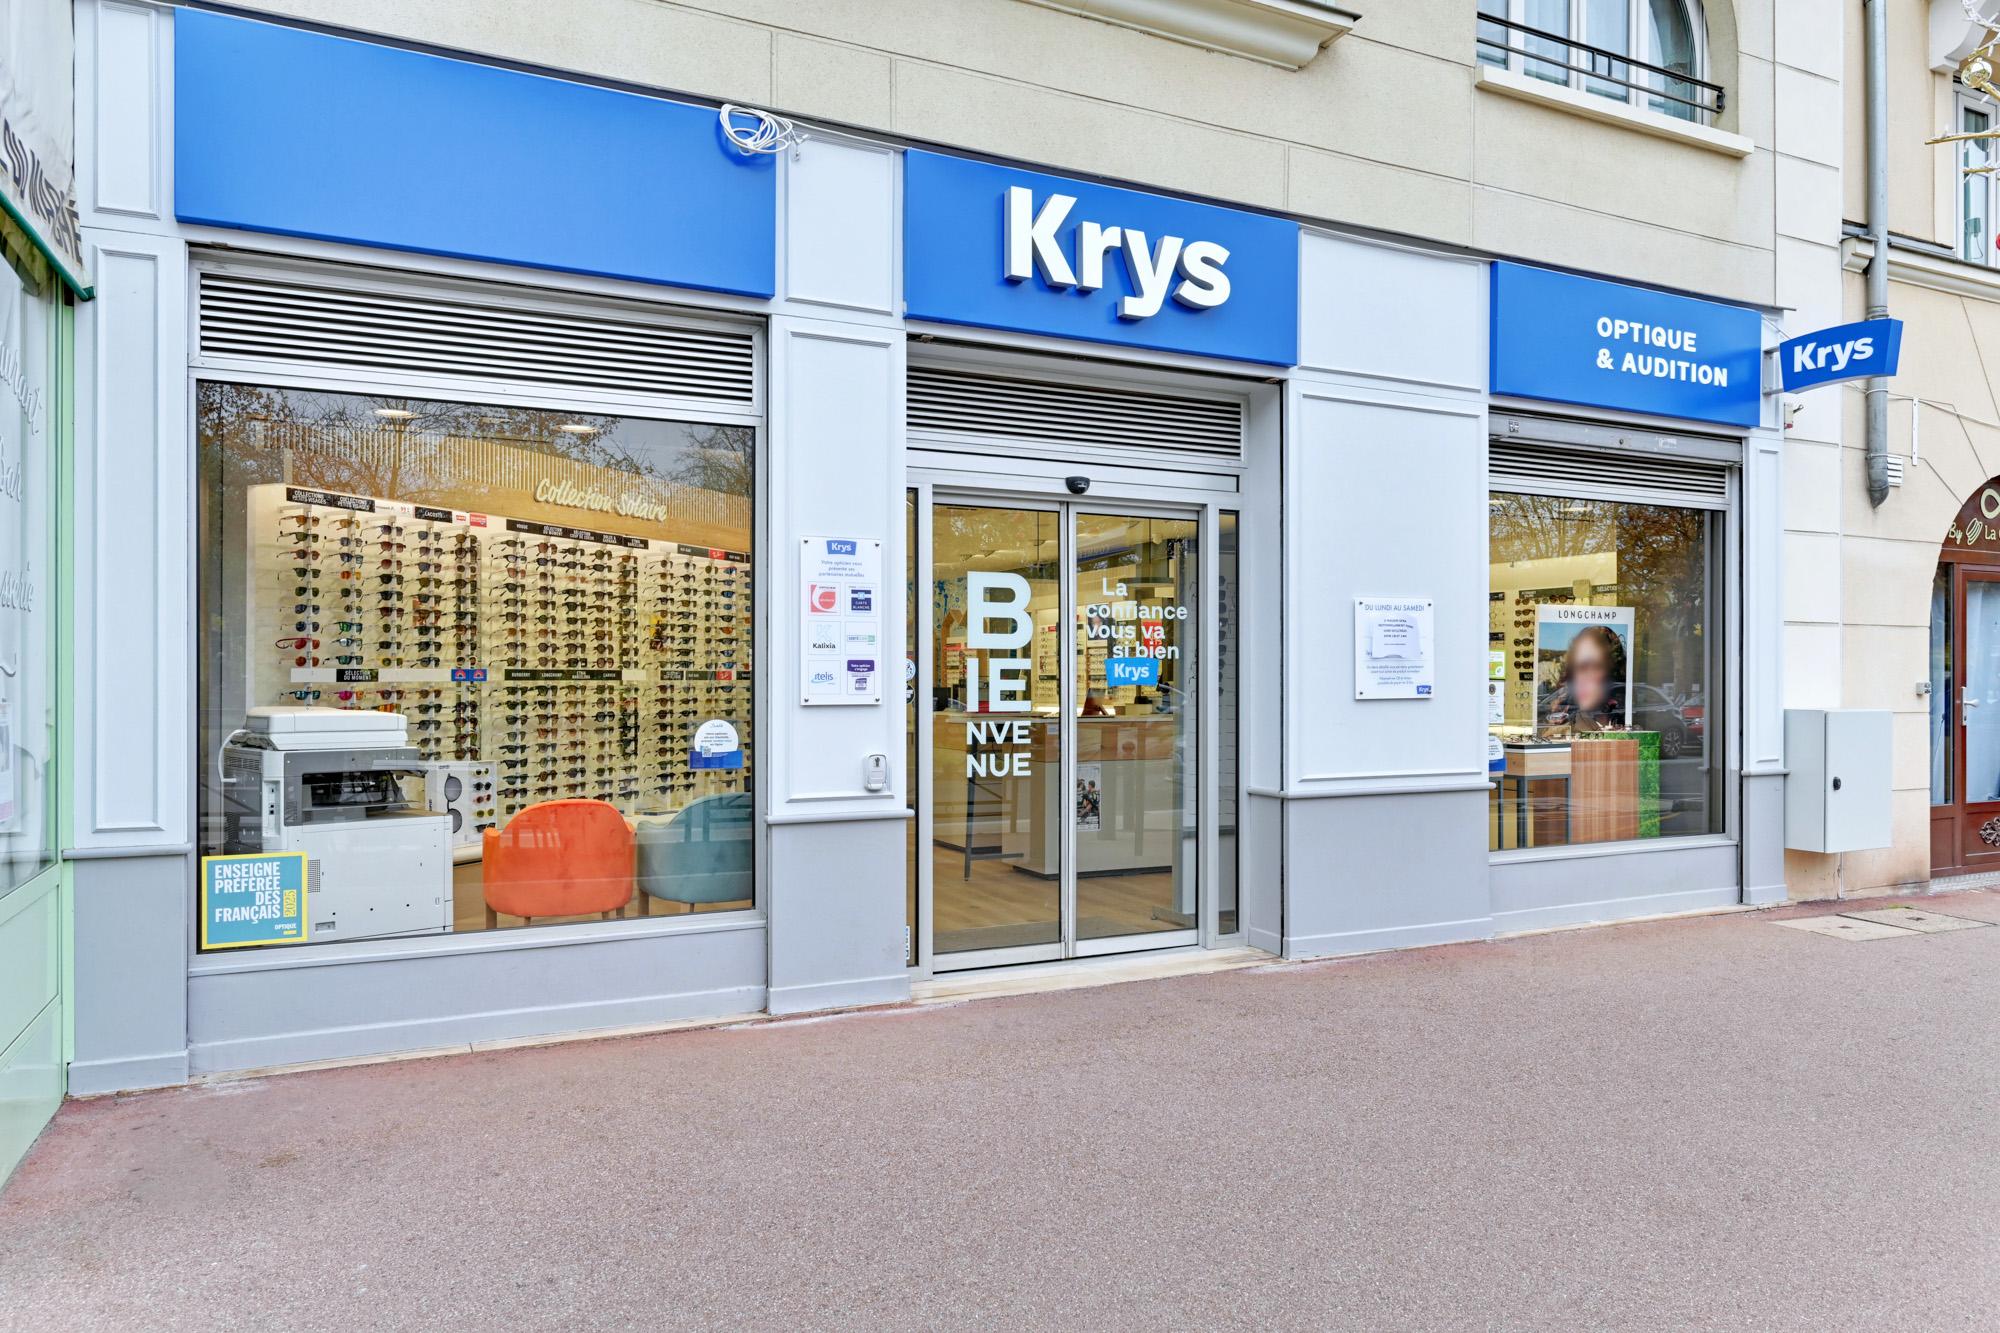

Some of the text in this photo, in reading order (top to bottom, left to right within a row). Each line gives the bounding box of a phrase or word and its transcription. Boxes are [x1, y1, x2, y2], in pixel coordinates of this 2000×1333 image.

[1004, 185, 1231, 321] Krys
[1596, 316, 1697, 353] OPTIQUE
[1793, 337, 1874, 373] Krys
[1596, 348, 1728, 387] & AUDITION
[534, 478, 667, 522] Collection Solaire
[1949, 522, 1963, 544] By
[831, 542, 852, 553] Krys
[1102, 577, 1128, 596] La
[967, 571, 1034, 649] B
[1086, 600, 1188, 620] confiance
[1558, 610, 1617, 620] LONGCHAMP
[1086, 624, 1166, 639] vous va
[812, 642, 836, 650] Kalixia
[1112, 641, 1180, 660] si bien
[814, 672, 834, 681] itelis
[1114, 663, 1149, 681] Krys
[966, 658, 1032, 712] IE
[966, 720, 1032, 745] NVE
[966, 752, 1032, 778] NUE
[214, 861, 281, 879] ENSEIGNE
[255, 890, 281, 906] DES
[214, 905, 281, 924] FRANÇAIS
[274, 923, 297, 931] OPTIQUE
